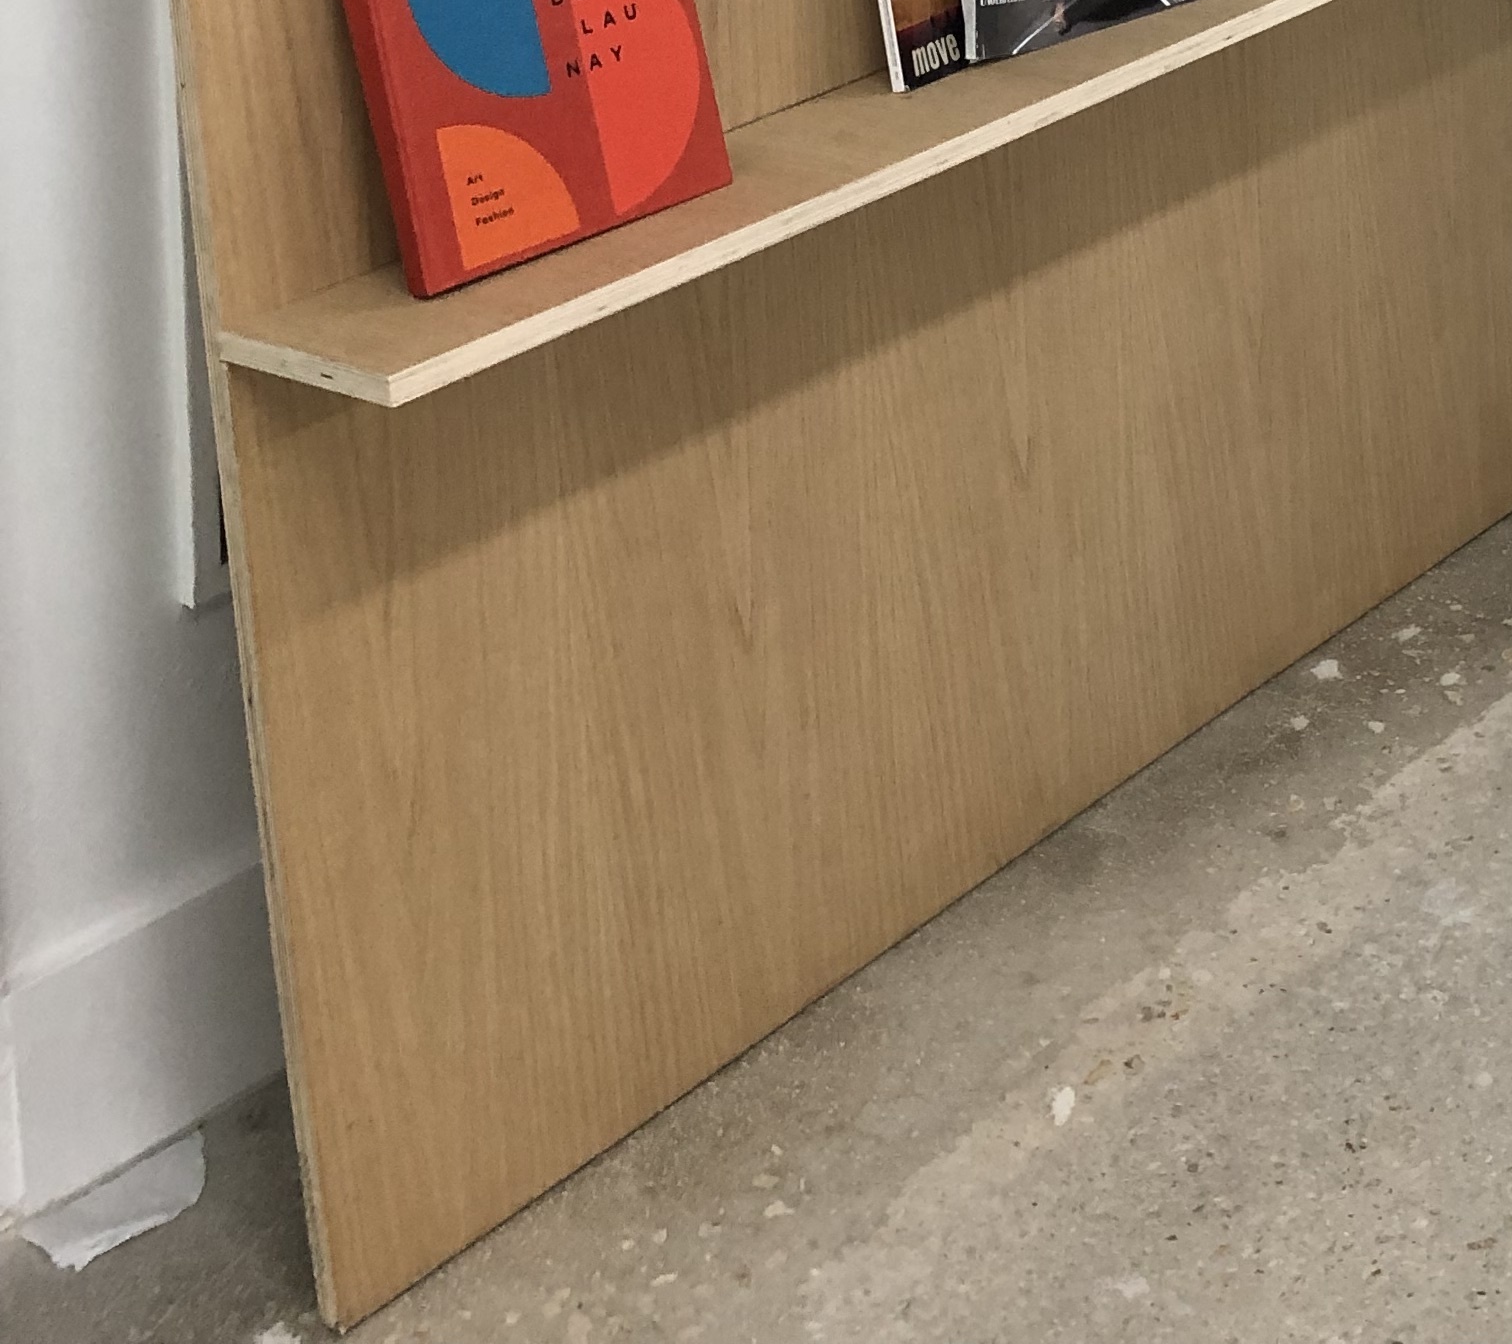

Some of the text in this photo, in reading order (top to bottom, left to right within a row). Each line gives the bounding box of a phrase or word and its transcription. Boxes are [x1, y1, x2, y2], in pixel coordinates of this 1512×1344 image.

[580, 3, 638, 35] LAU
[566, 44, 622, 78] NAY
[911, 33, 961, 78] move
[471, 188, 505, 206] Design
[475, 206, 515, 227] Fashion
